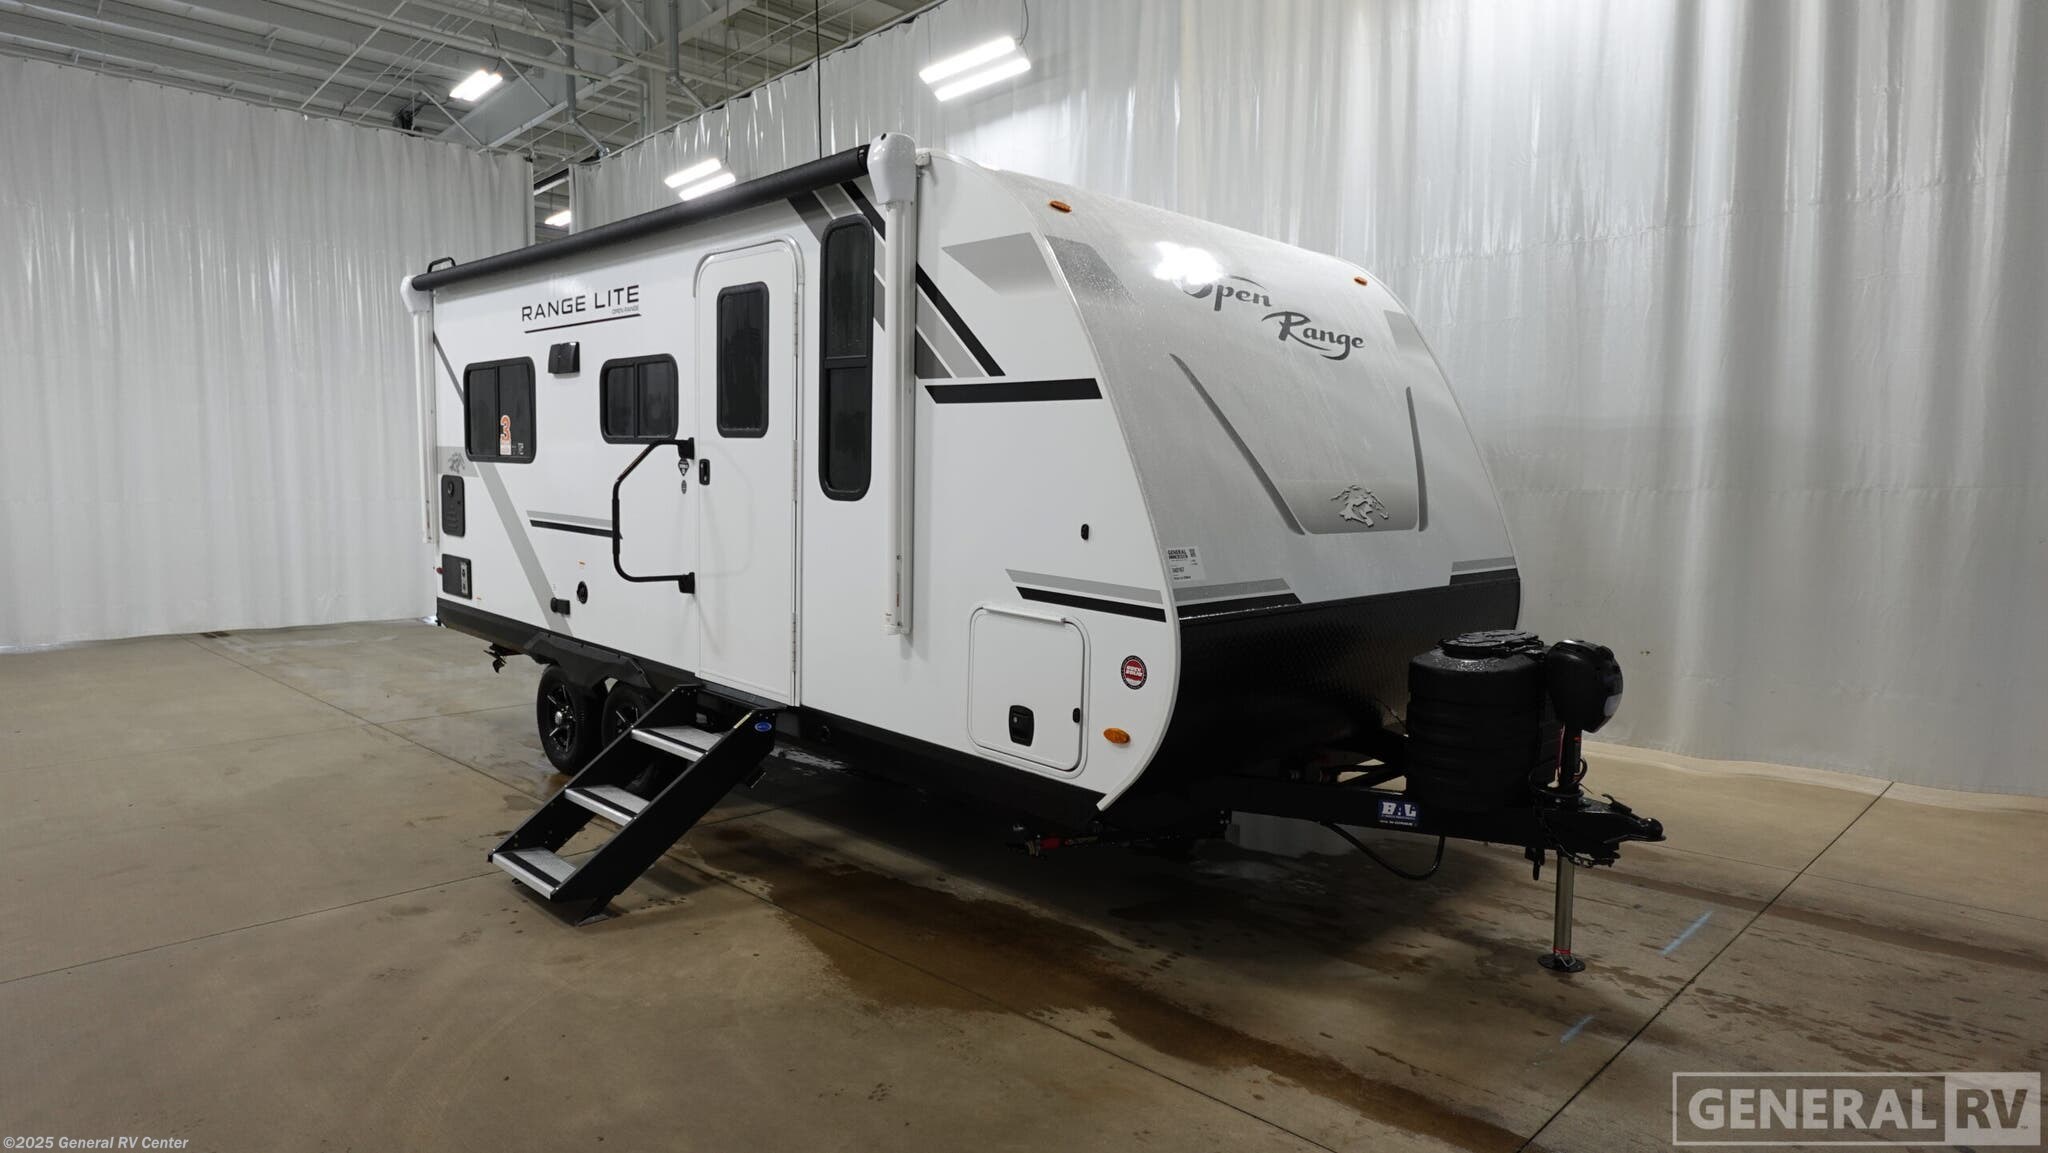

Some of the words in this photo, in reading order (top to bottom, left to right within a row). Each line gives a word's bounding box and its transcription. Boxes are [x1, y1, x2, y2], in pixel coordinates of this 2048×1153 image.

[522, 295, 586, 321] RANGE
[594, 284, 639, 309] LITE
[1261, 311, 1365, 361] Range
